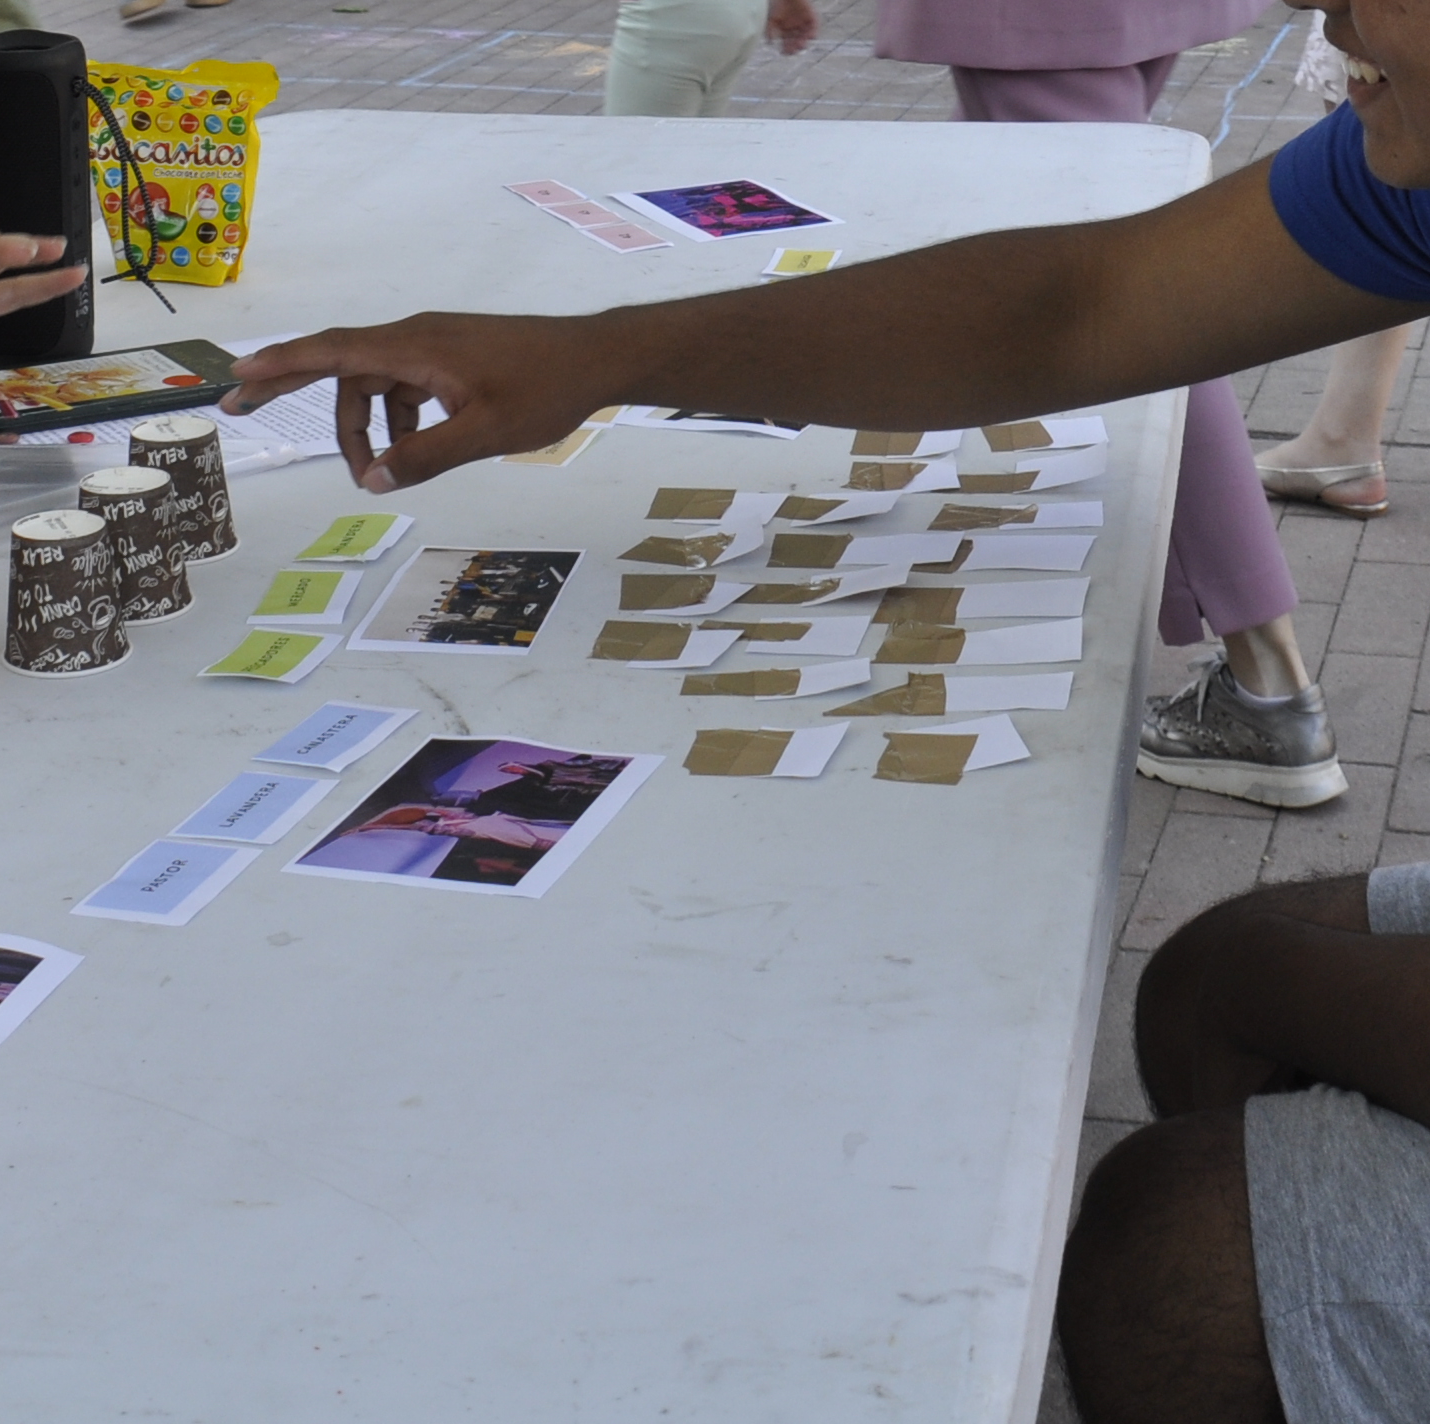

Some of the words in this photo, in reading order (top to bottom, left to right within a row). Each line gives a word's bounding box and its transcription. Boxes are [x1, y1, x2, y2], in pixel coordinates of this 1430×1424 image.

[147, 447, 188, 467] RELAX
[103, 498, 147, 522] RELAX
[176, 491, 204, 514] DRIN
[22, 546, 65, 567] RELAX
[72, 541, 111, 577] Coffee
[118, 536, 137, 556] TO
[123, 545, 163, 574] DRINK
[34, 583, 53, 604] TO
[288, 578, 311, 607] MERCADO
[39, 595, 82, 624] DRINK
[297, 714, 358, 756] CANASTERA
[219, 781, 280, 829] LAVANDERA
[140, 859, 189, 893] PASTOR
